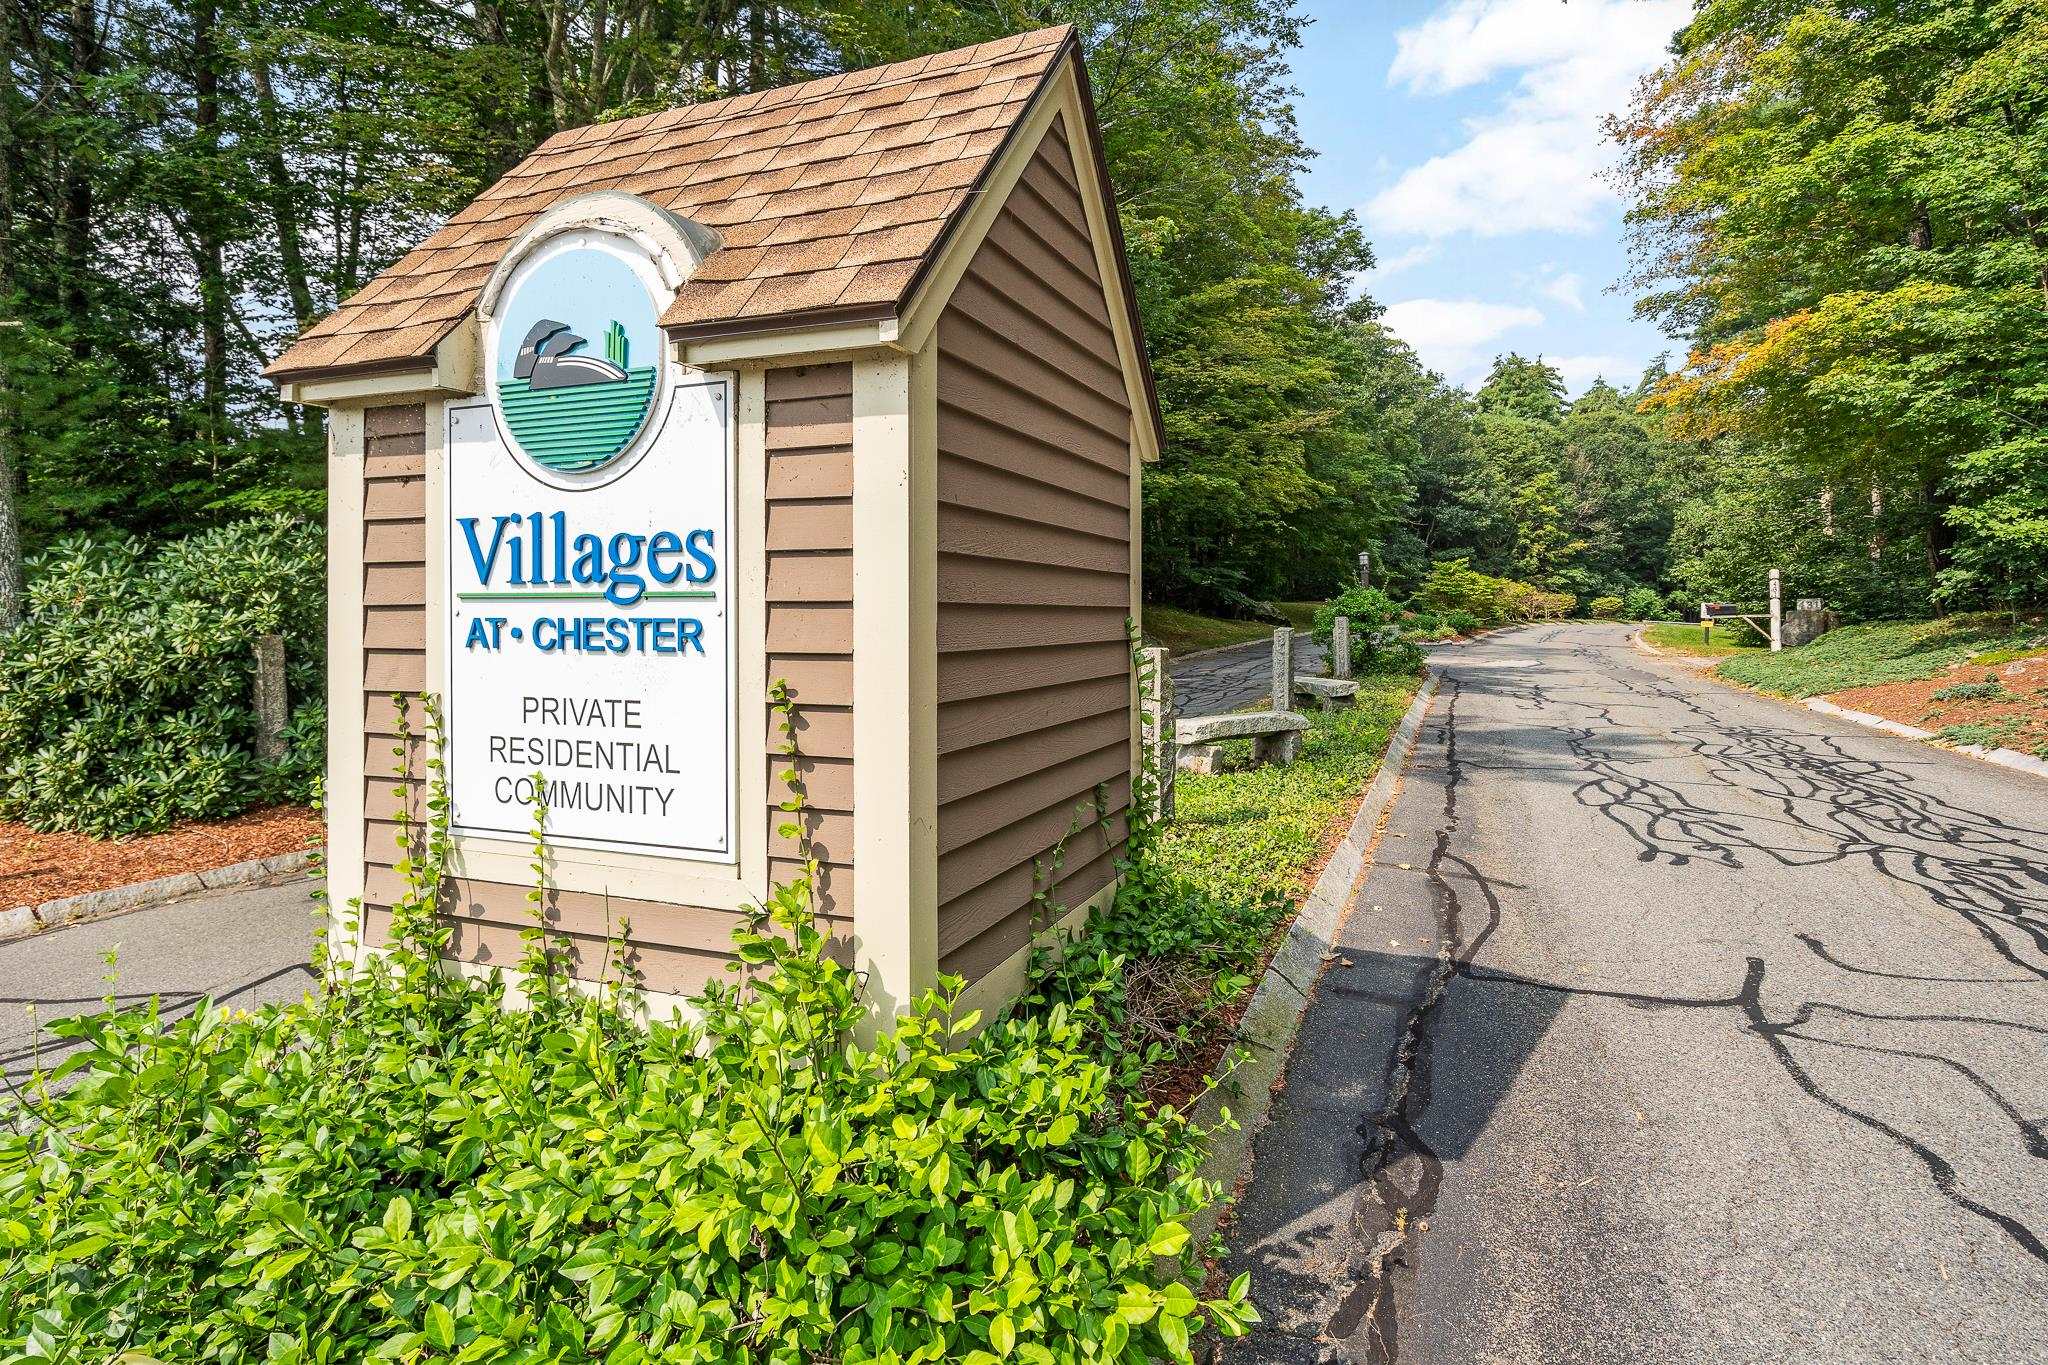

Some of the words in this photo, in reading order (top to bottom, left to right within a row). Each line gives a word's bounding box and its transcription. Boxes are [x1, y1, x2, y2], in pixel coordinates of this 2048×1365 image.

[456, 511, 717, 605] Villages
[532, 617, 705, 653] CHESTER
[522, 696, 642, 729] PRIVATE
[489, 735, 681, 774] RESIDENTIAL
[494, 776, 675, 817] COMMUNITY
